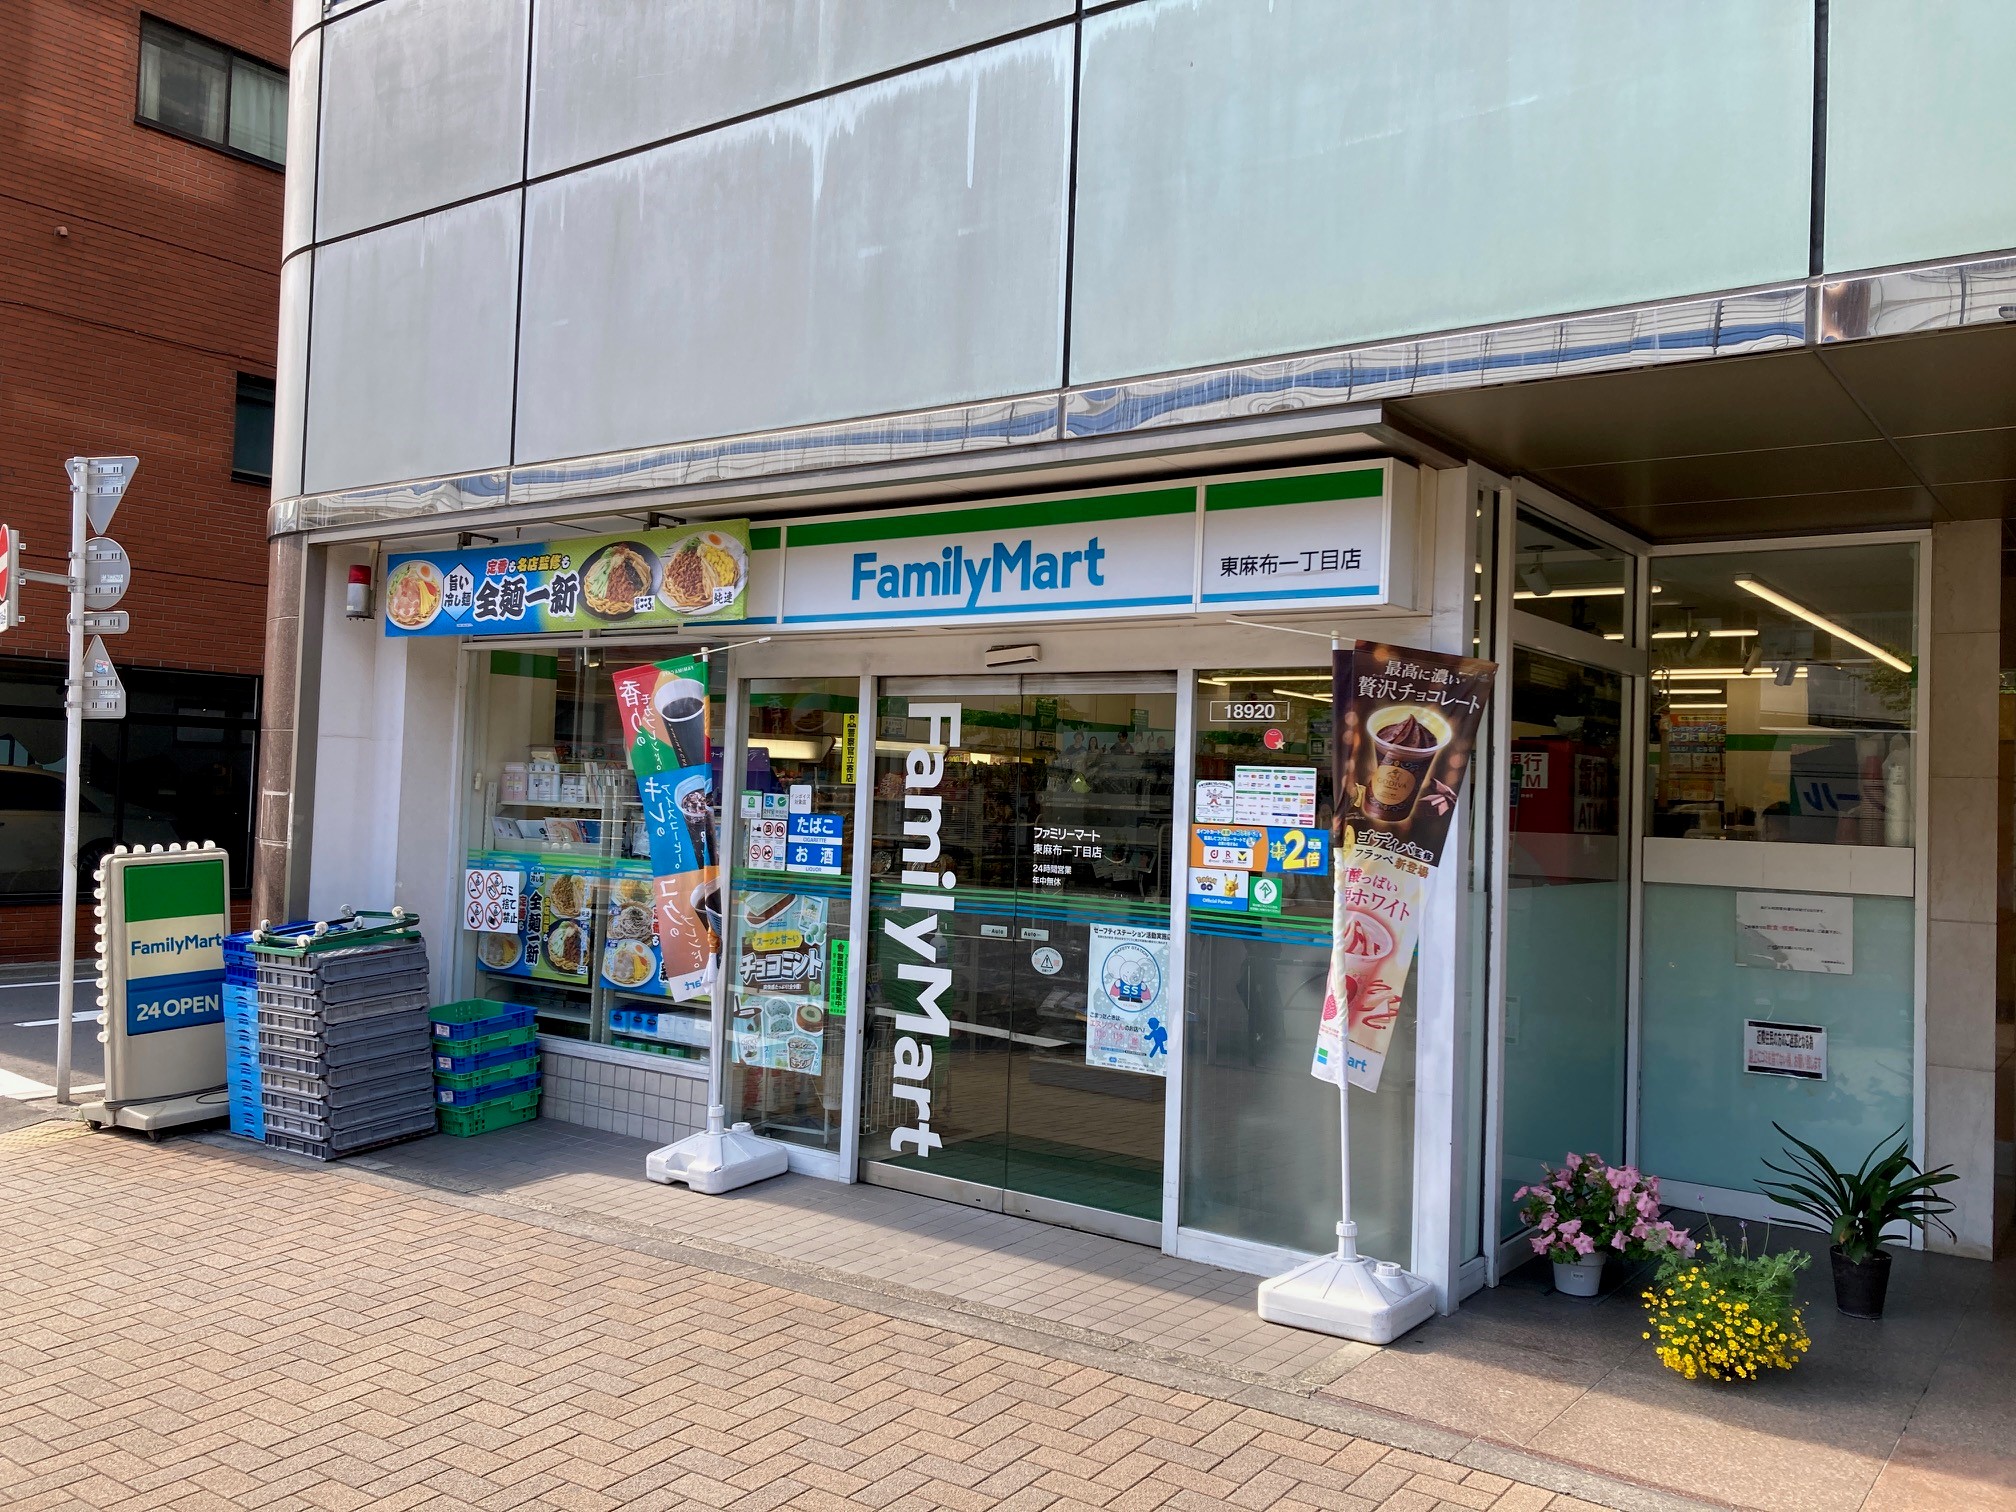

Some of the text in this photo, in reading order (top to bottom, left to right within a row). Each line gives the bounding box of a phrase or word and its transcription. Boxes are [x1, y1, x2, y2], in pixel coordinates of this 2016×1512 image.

[1220, 548, 1362, 578] 東麻布一丁目店
[852, 536, 1106, 609] FamilyMart
[449, 574, 470, 591] 旨い
[444, 591, 471, 608] 冷し麺
[474, 572, 579, 619] 全麺一新
[1385, 660, 1461, 685] 最高に濃い
[1358, 675, 1480, 714] 贅沢チョコレート
[1224, 703, 1275, 719] 18920
[1377, 777, 1407, 789] GODIVA
[797, 816, 834, 835] たばこ
[1034, 827, 1101, 840] ファミリーマート
[1033, 843, 1103, 859] 東麻布一丁目店
[1357, 829, 1434, 861] ゴディバ監修
[820, 847, 834, 865] 酒
[1032, 864, 1072, 875] 24時間営業
[1032, 876, 1061, 887] 年中無休
[1200, 883, 1213, 891] GO
[500, 885, 514, 897] ゴミ
[501, 899, 516, 910] 捨て
[502, 912, 517, 924] 禁止
[525, 889, 543, 966] 全麺一新
[885, 702, 962, 1158] FamilyMart
[1023, 930, 1037, 938] Auto
[131, 932, 221, 956] FamilyMart
[1114, 945, 1150, 958] SAFETY STATION
[738, 947, 823, 986] チョコミント
[1123, 985, 1139, 995] SS
[136, 994, 218, 1021] 24 OPEN
[1347, 1052, 1367, 1072] art
